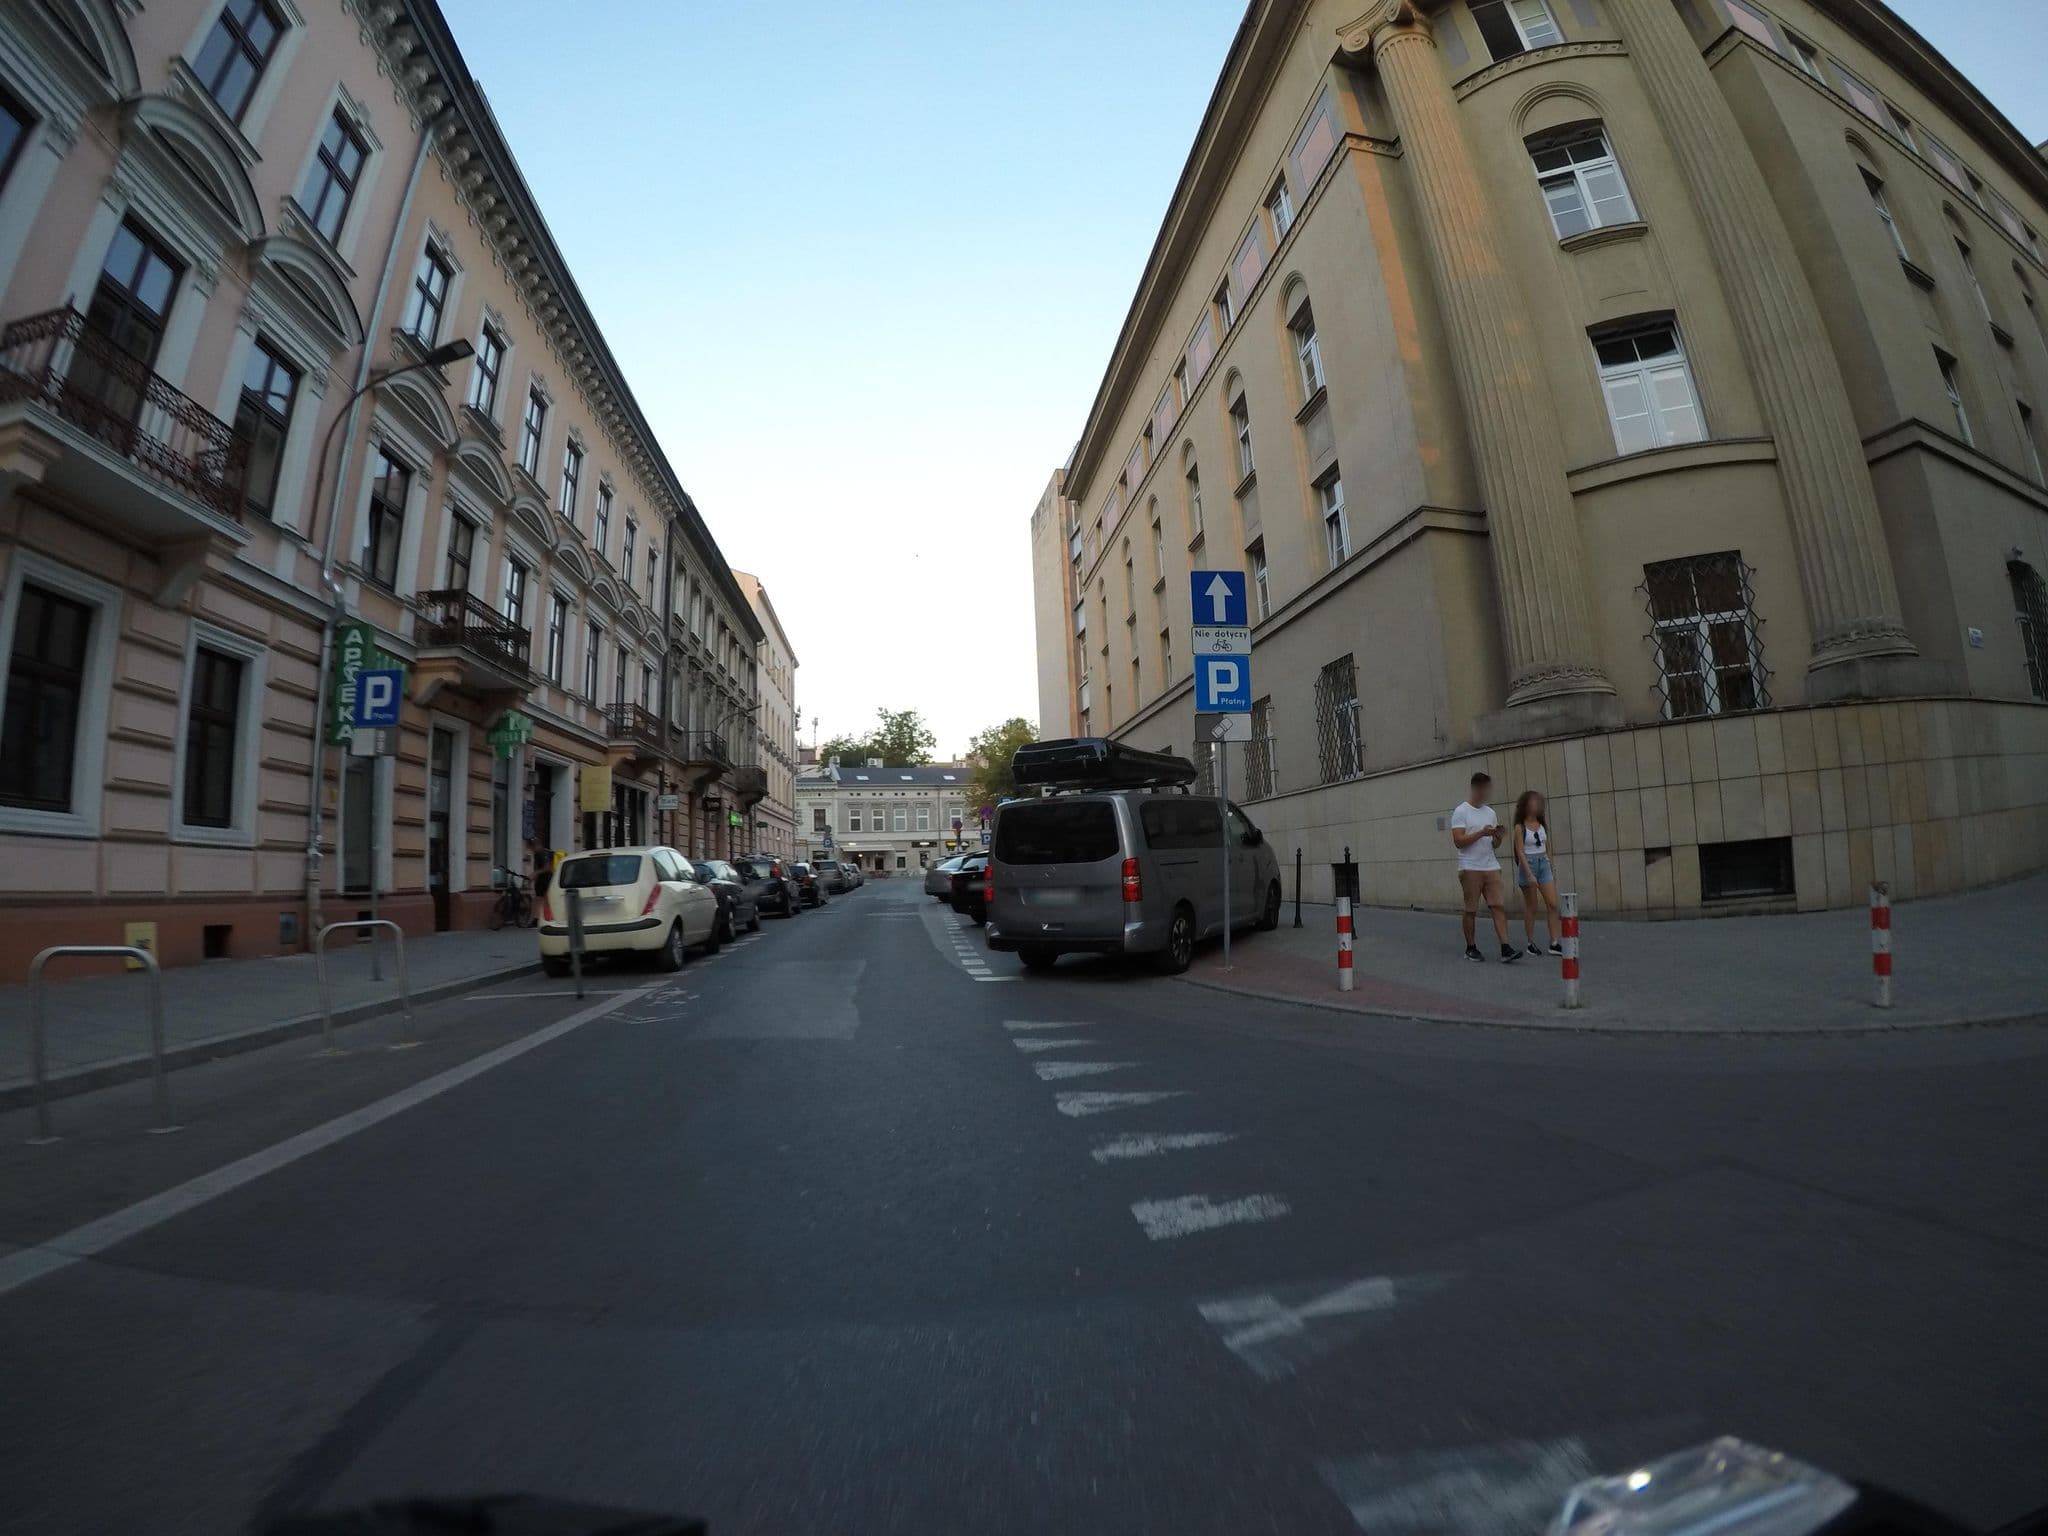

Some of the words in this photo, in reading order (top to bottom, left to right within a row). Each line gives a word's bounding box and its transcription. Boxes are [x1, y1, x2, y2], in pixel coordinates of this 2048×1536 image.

[1195, 630, 1210, 638] Nie
[1214, 630, 1248, 640] dotyczy
[363, 676, 393, 720] P
[1208, 661, 1239, 705] P
